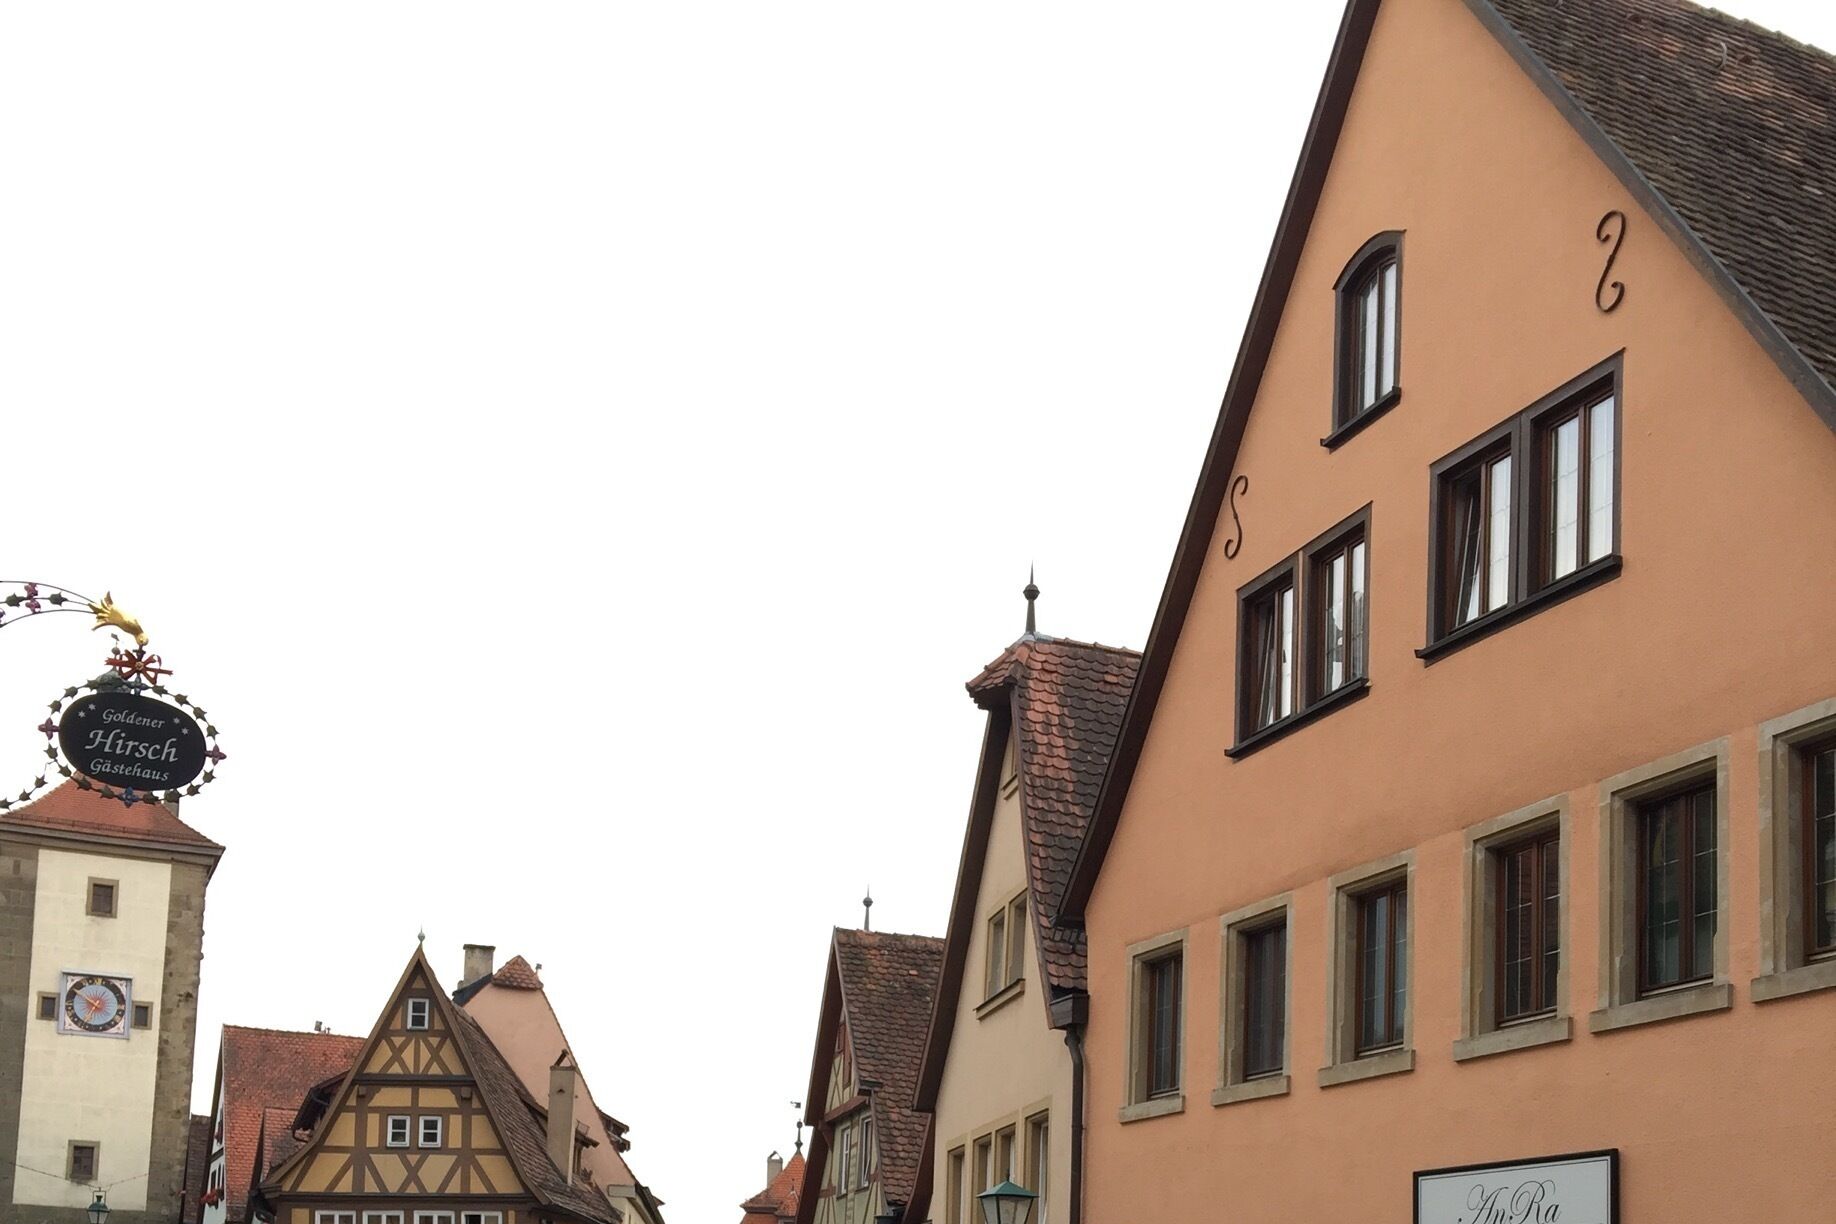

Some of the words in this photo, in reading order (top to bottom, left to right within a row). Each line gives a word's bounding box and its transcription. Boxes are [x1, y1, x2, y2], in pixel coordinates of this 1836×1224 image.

[102, 708, 165, 730] Goldener
[84, 729, 179, 762] Hirsch
[90, 758, 169, 781] Gästehaus
